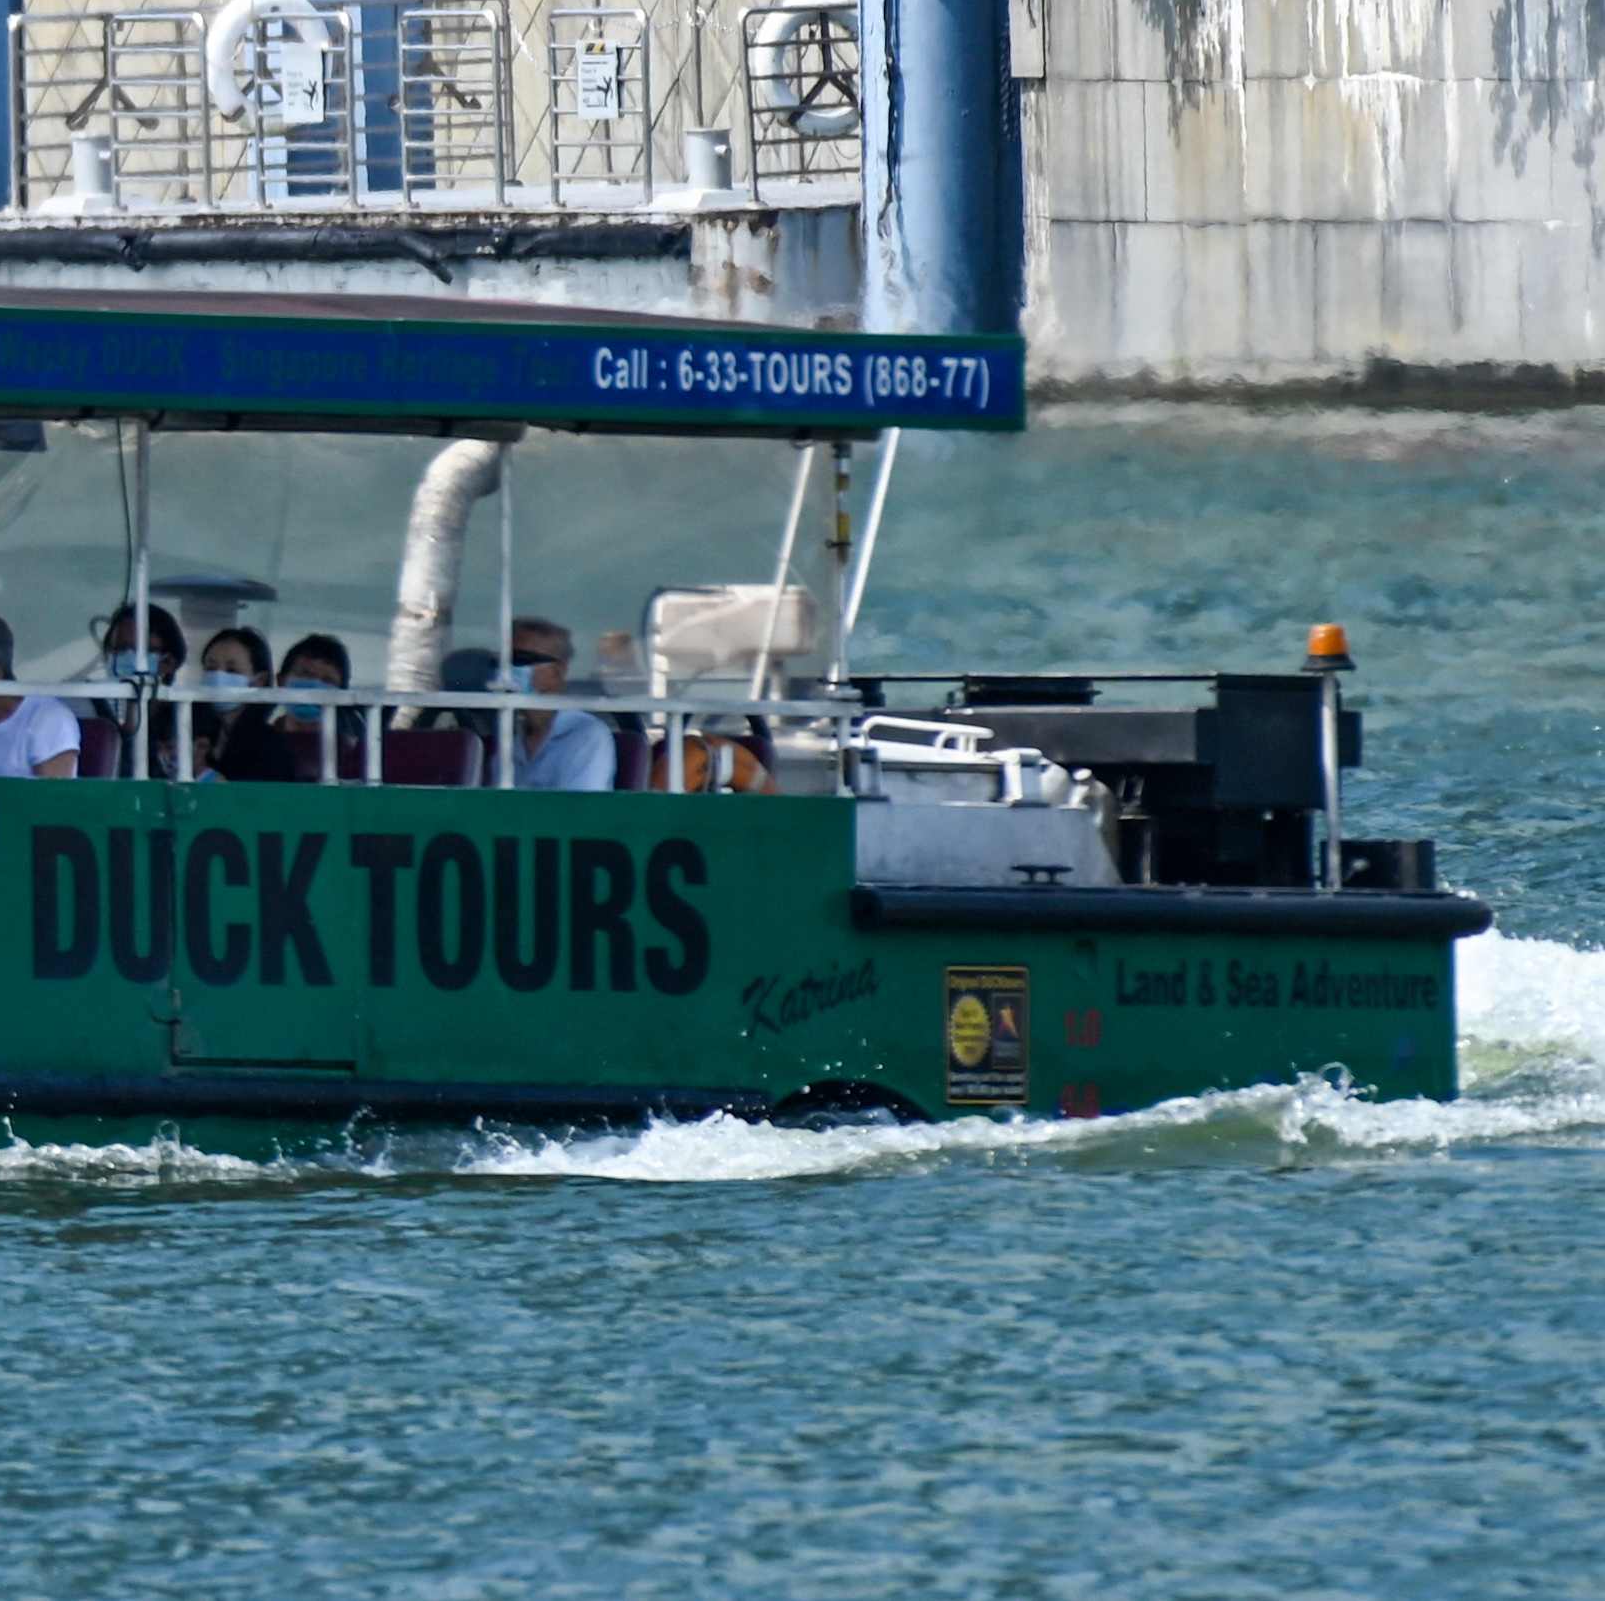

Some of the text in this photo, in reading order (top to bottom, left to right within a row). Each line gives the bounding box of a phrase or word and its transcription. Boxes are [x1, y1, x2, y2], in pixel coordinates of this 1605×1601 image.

[594, 346, 648, 390] Call
[659, 358, 668, 389] :
[678, 349, 853, 396] 6-33-TOURS
[863, 354, 990, 409] (868-77)
[30, 824, 713, 996] DUCK TOURS
[1115, 957, 1438, 1010] Land & Sea Adventure
